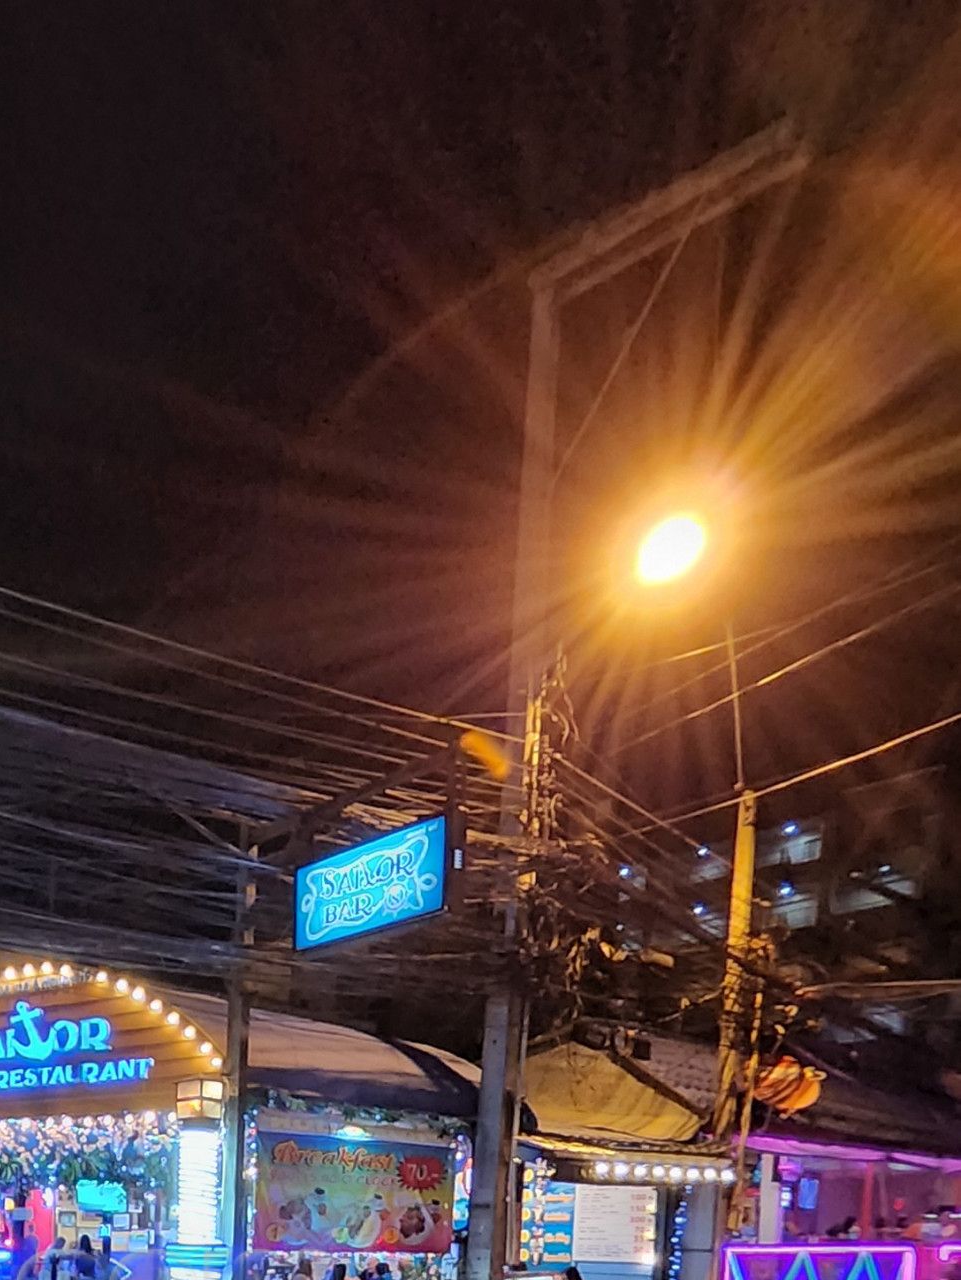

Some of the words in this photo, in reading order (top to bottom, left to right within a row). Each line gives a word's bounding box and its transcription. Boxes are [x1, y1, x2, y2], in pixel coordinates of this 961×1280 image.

[320, 850, 415, 898] SAILOR
[323, 893, 374, 924] BAR
[271, 1140, 397, 1174] Breakfast
